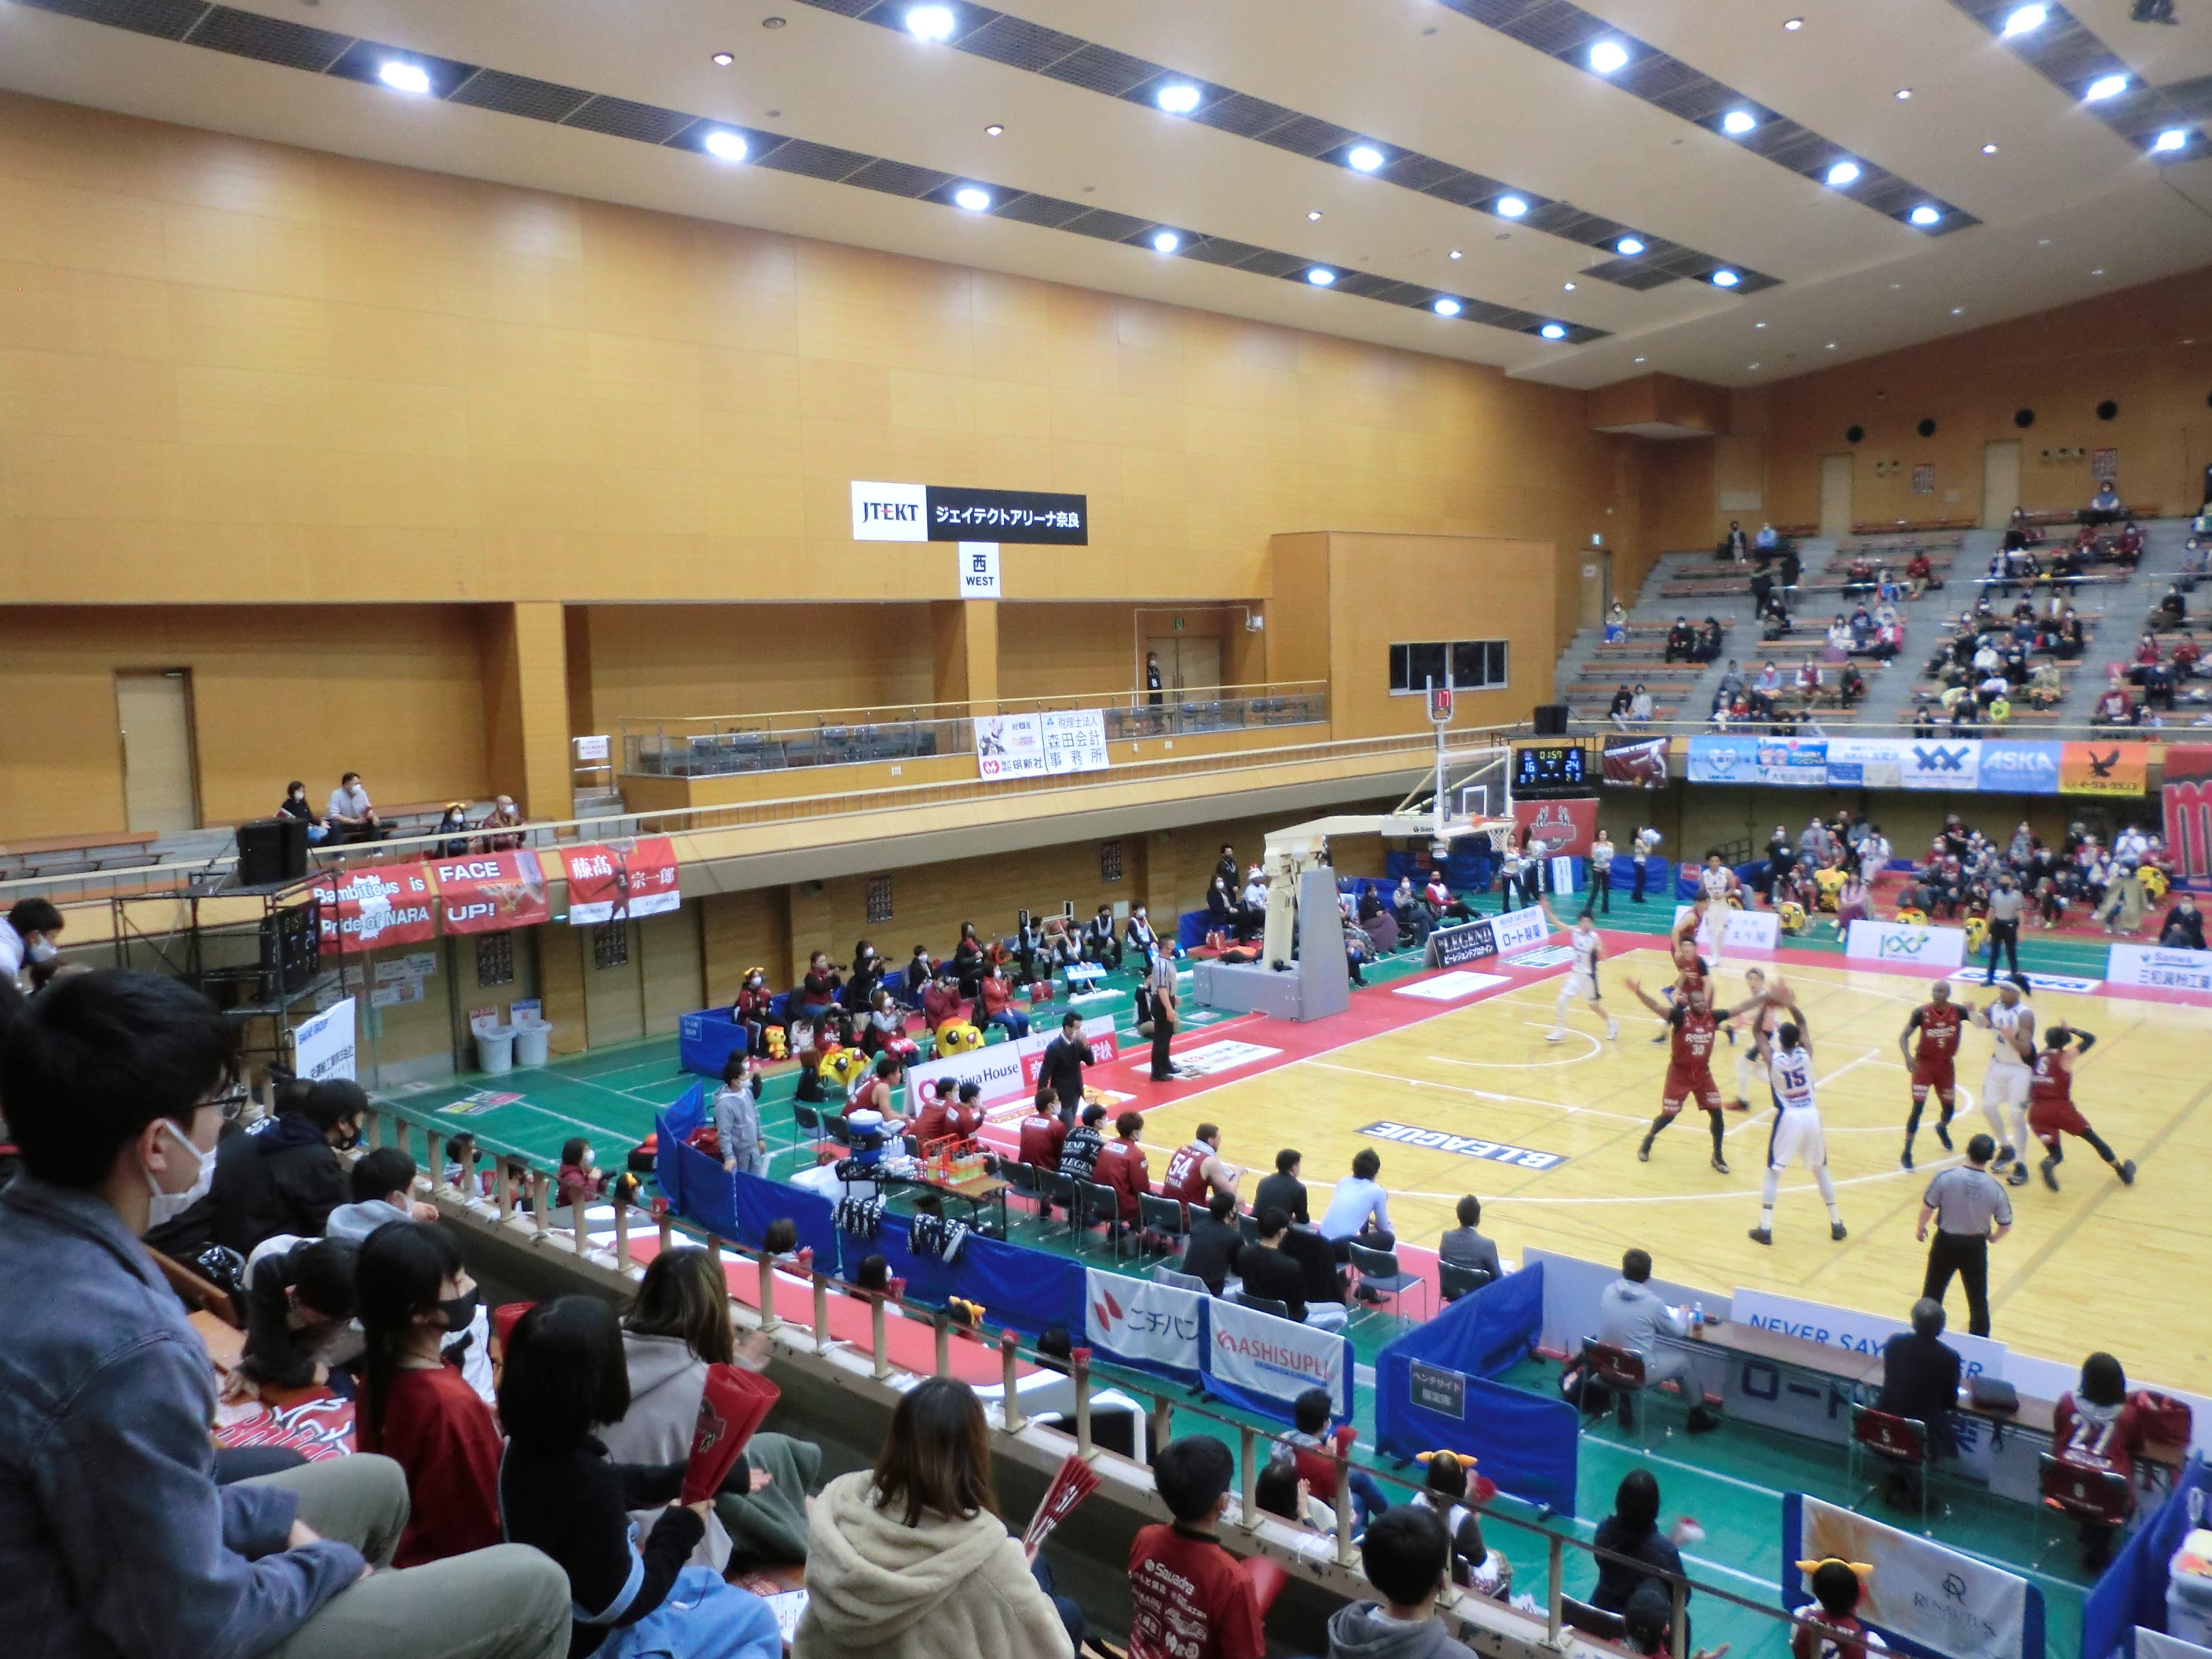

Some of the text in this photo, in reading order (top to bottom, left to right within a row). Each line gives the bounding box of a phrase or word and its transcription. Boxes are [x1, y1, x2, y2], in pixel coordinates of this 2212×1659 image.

[862, 502, 919, 523] JTEKT
[936, 505, 1080, 529] ジェイテクトアリーナ奈良
[972, 554, 987, 573] 西
[965, 576, 994, 586] WEST
[1438, 690, 1449, 707] 17
[1058, 716, 1099, 729] 税理士法人
[1047, 730, 1101, 749] 森田会計
[1525, 761, 1536, 772] 16
[1565, 760, 1580, 771] 24
[1982, 750, 2056, 771] ASKA
[438, 861, 500, 882] FACE
[631, 866, 676, 889] 宗一郎
[313, 876, 425, 904] Bambitious is
[320, 906, 430, 935] Pride of NARA
[448, 903, 495, 921] UP!
[1692, 1045, 1705, 1056] 30
[983, 1063, 1019, 1081] House
[1782, 1067, 1807, 1090] 15
[1168, 1152, 1194, 1180] 54
